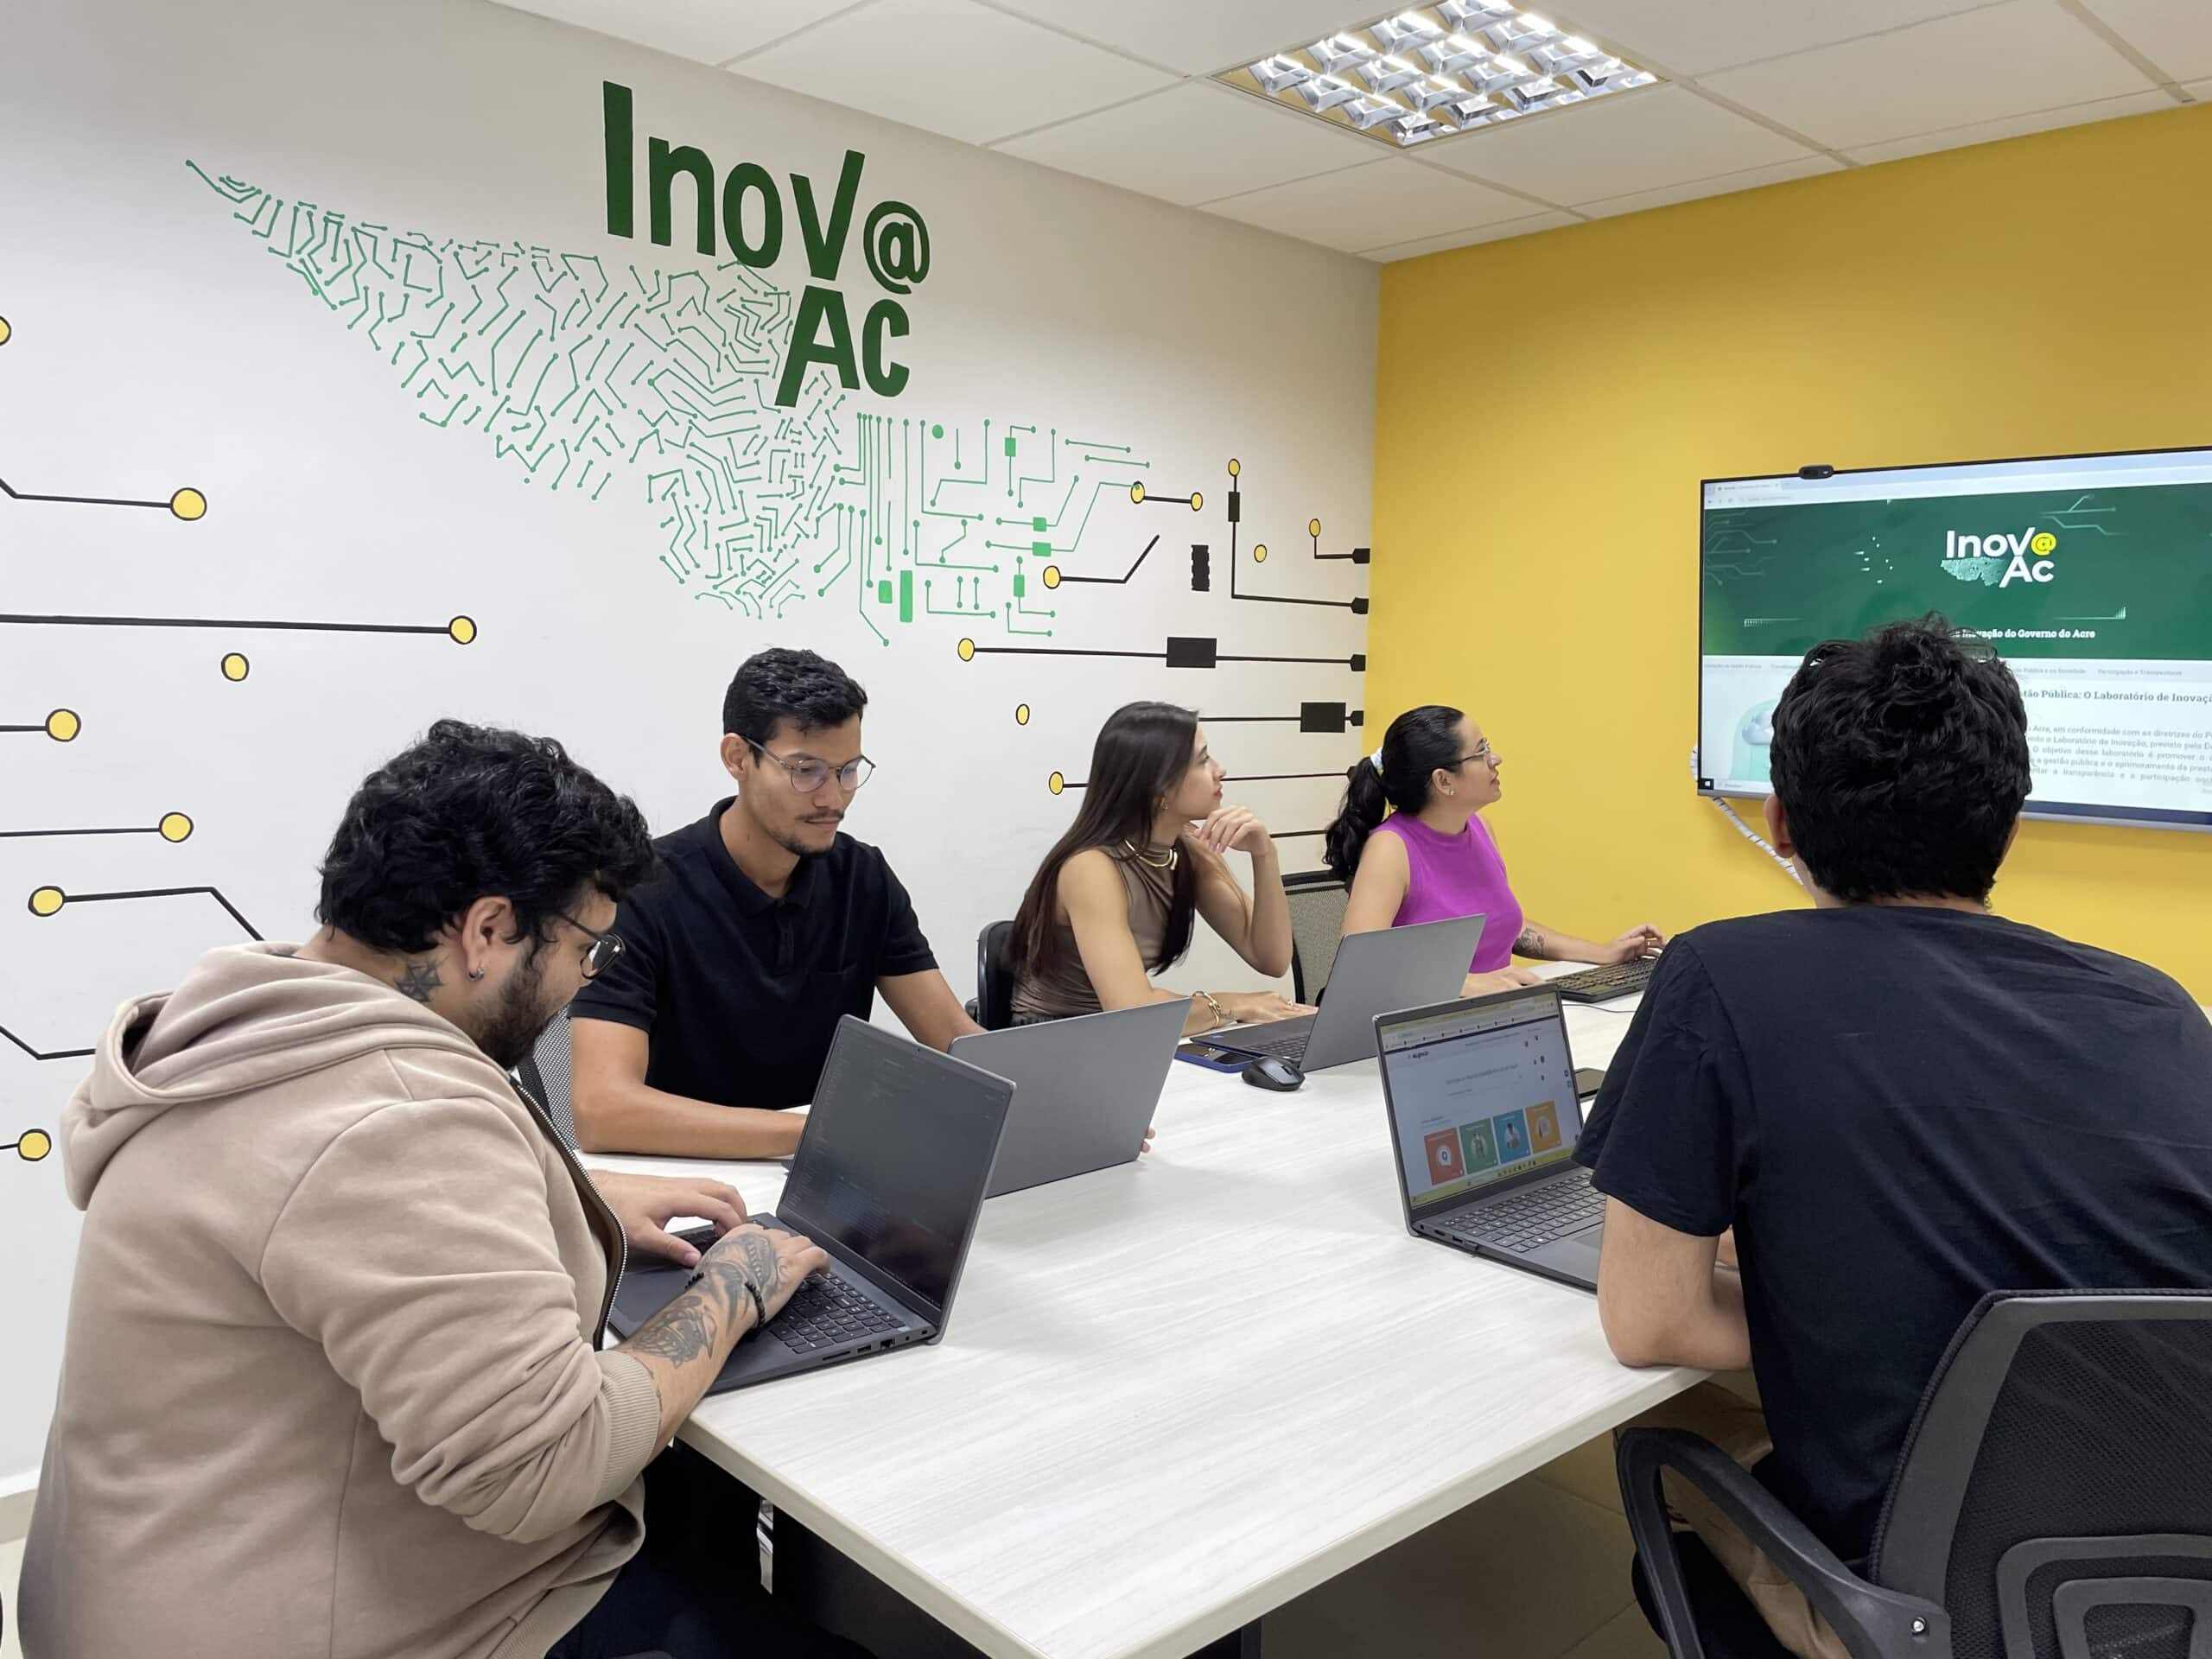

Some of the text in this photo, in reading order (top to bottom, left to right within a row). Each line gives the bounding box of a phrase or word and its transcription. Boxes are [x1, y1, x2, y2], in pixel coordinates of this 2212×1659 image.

[774, 284, 910, 408] Ac
[1999, 556, 2055, 588] Ac
[2005, 629, 2016, 638] do
[2059, 629, 2070, 638] do
[2083, 690, 2092, 699] O
[2094, 690, 2154, 701] Laboratório
[2157, 692, 2169, 701] de
